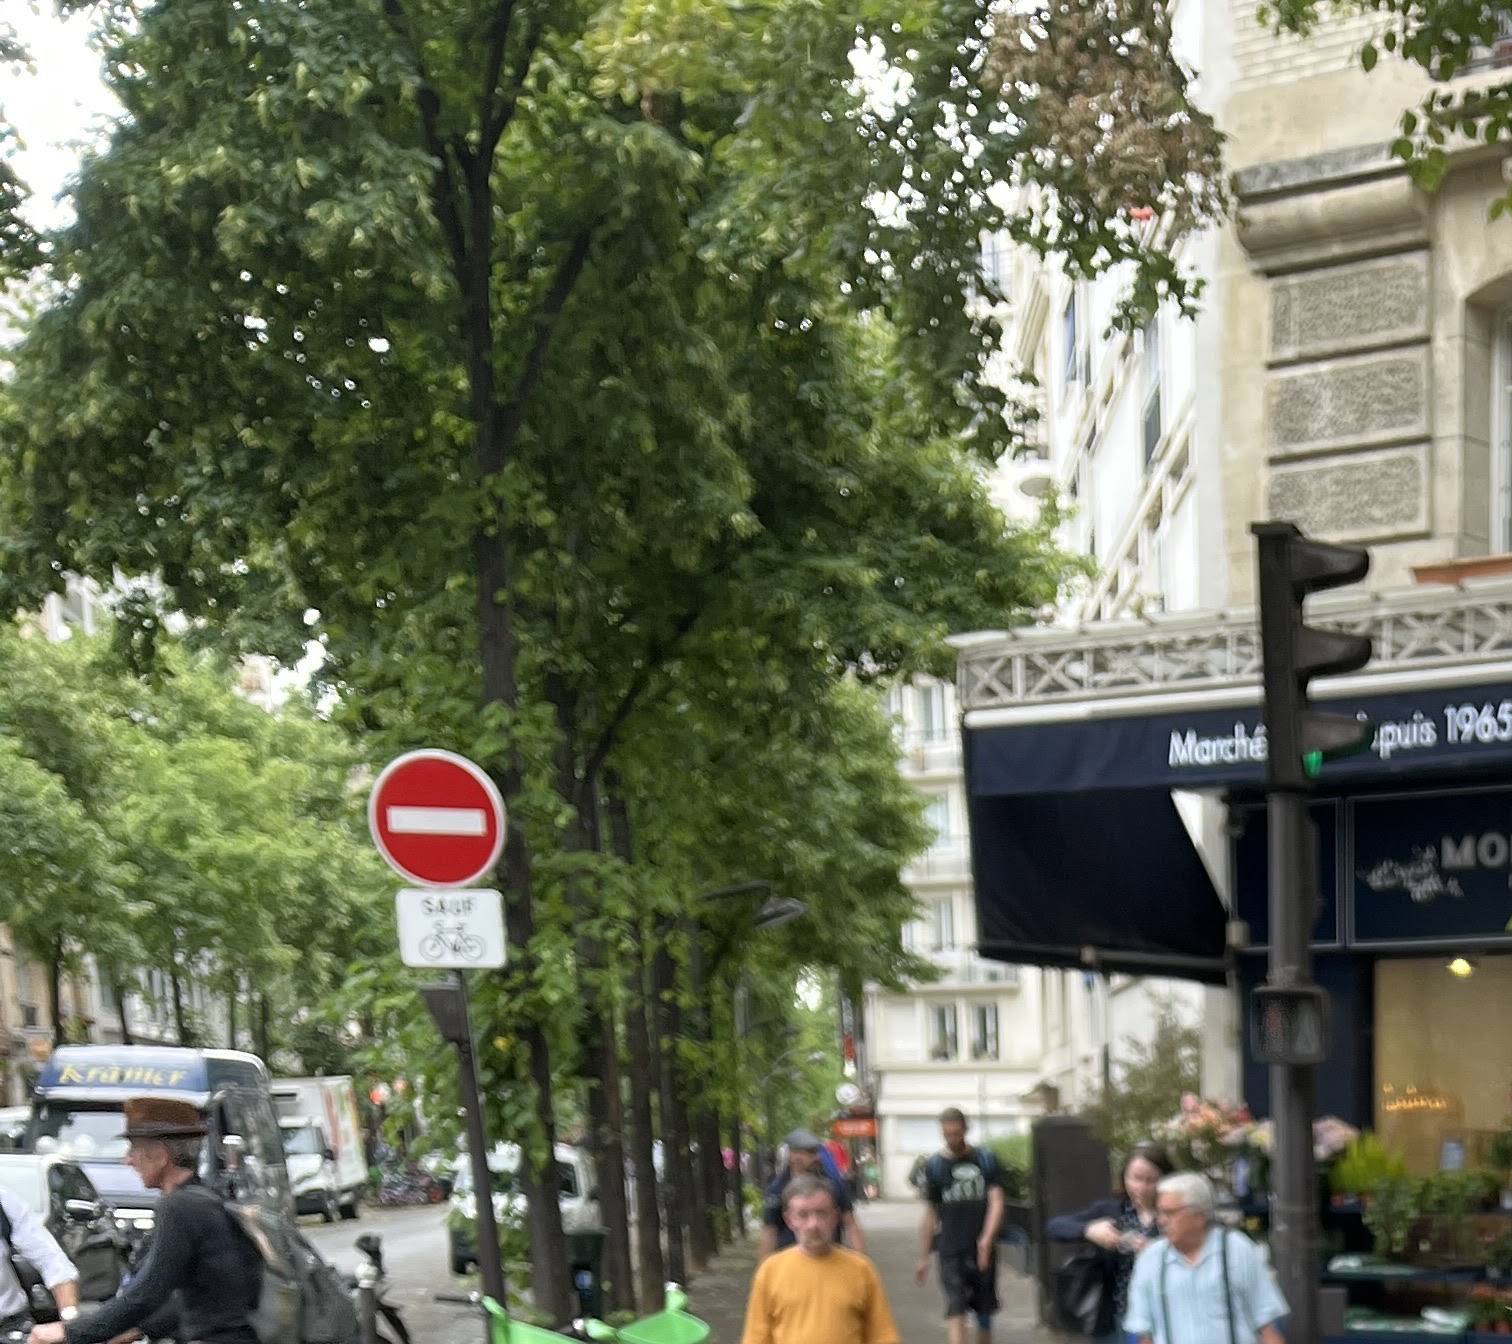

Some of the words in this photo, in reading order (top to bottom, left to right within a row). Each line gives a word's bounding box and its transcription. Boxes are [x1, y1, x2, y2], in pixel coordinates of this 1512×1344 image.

[1168, 720, 1268, 767] Marché
[1356, 709, 1437, 760] puis
[421, 896, 478, 917] SAUF
